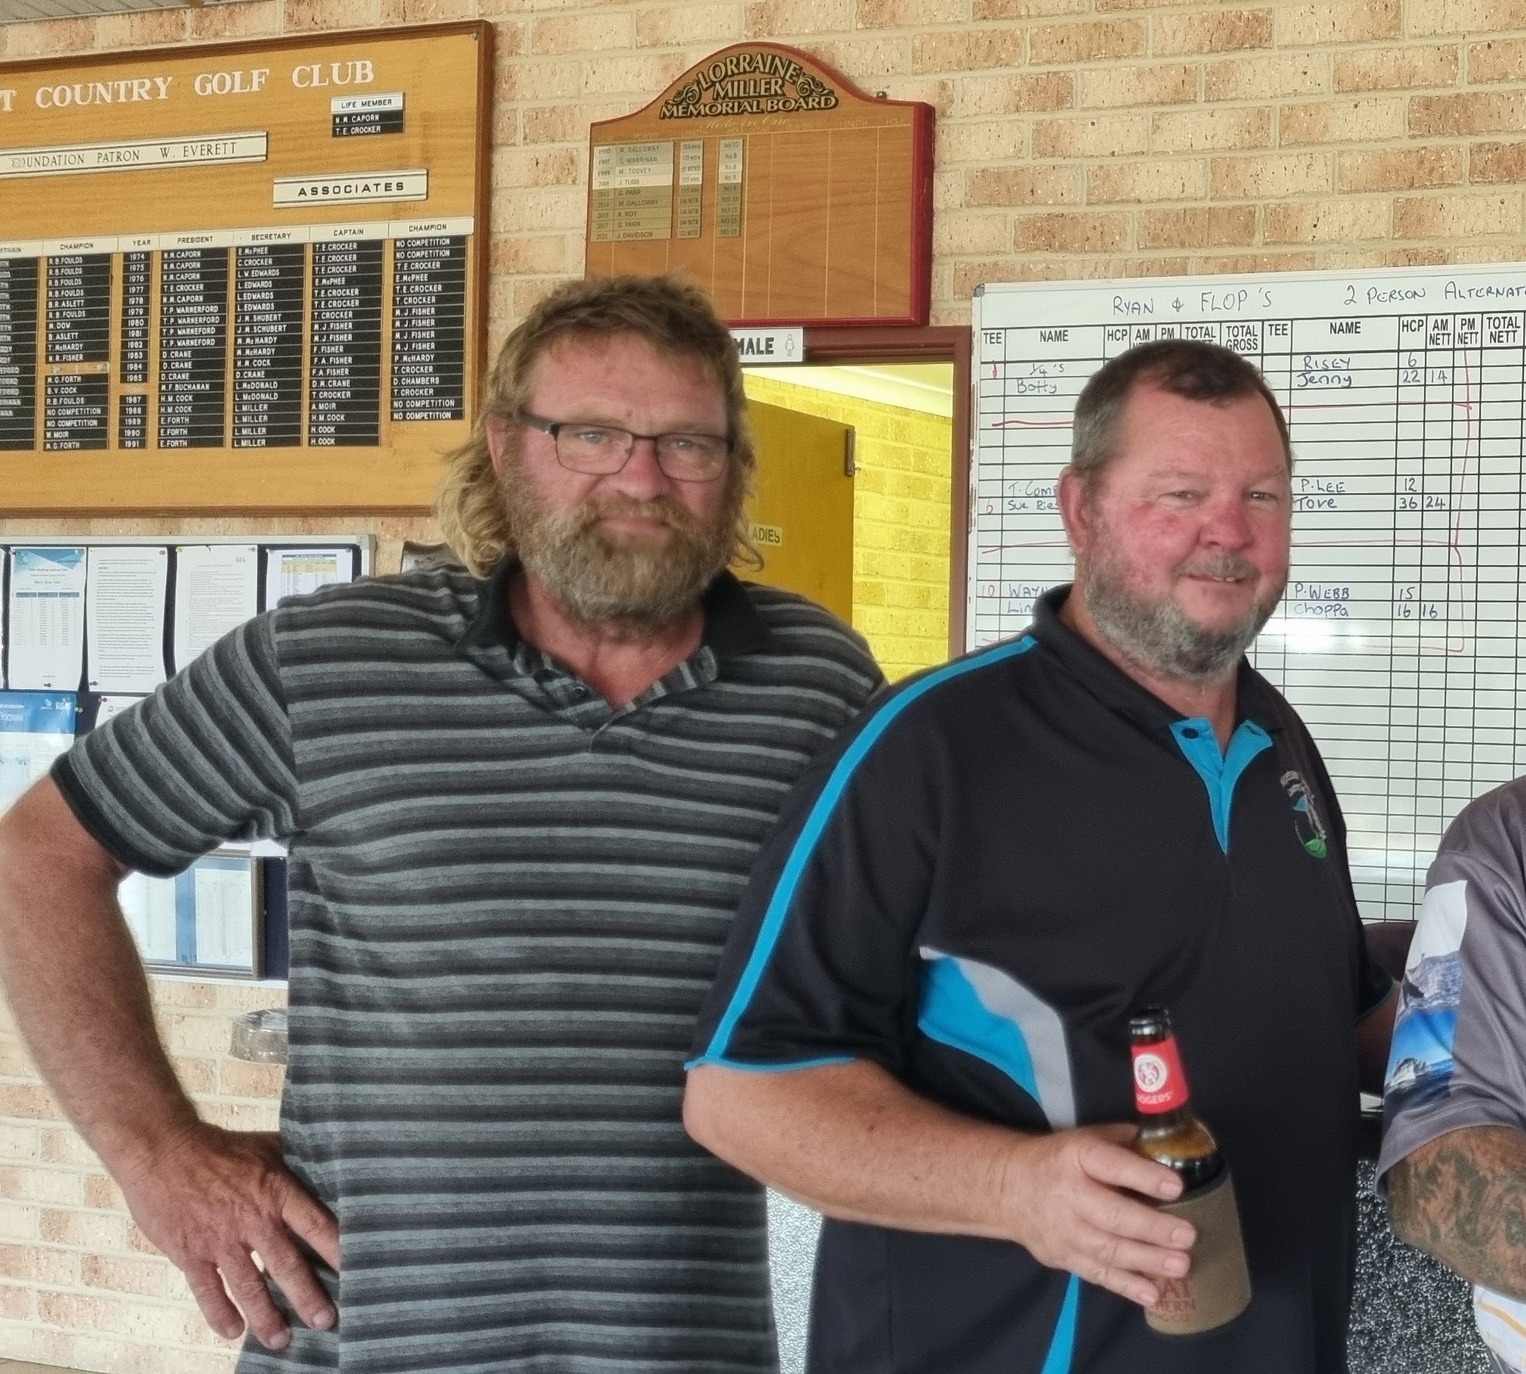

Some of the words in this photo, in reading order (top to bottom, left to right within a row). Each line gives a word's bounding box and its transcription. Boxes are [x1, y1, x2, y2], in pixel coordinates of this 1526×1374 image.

[697, 53, 801, 90] LORRAINE
[35, 77, 173, 108] COUNTRY
[194, 69, 270, 95] GOLF
[292, 60, 374, 88] CLUB
[713, 78, 784, 99] MILLER
[341, 100, 357, 109] LIFE
[361, 99, 392, 107] MEMBER
[660, 100, 762, 119] MEMORIAL
[765, 96, 837, 113] BOARD
[9, 154, 85, 168] UNDATION
[97, 150, 140, 164] PATRON
[183, 142, 237, 157] EVERETT
[298, 182, 404, 196] ASSOCIATES
[408, 224, 447, 232] CHAMPION
[251, 233, 292, 241] SECRETARY
[407, 238, 450, 247] COMPETITION
[1344, 285, 1357, 305] 2
[1367, 287, 1426, 304] PERSON
[1113, 296, 1154, 315] RYAN
[1329, 322, 1361, 335] NAME
[1401, 320, 1424, 333] HCP
[1432, 318, 1448, 331] AM
[1460, 318, 1475, 330] PM
[1486, 316, 1521, 329] TOTAL
[1039, 330, 1069, 342] NAME
[1107, 329, 1127, 341] HCP
[1135, 328, 1150, 340] AM
[1161, 327, 1175, 339] PM
[1185, 326, 1216, 338] TOTAL
[1226, 324, 1258, 337] TOTAL
[1268, 324, 1288, 336] TEE
[1489, 330, 1518, 343] NETT
[983, 332, 1002, 344] TEE
[1225, 338, 1258, 350] GROSS
[1429, 333, 1451, 346] NETT
[1457, 332, 1479, 345] NETT
[1407, 351, 1417, 367] 6
[1297, 372, 1352, 387] Jenny
[1402, 370, 1421, 383] 22
[1430, 370, 1447, 383] 14
[57, 407, 101, 415] COMPETITION
[1405, 477, 1417, 491] 12
[1399, 497, 1418, 509] 36
[1425, 496, 1446, 510] 24
[751, 526, 781, 544] ADIES
[1400, 587, 1415, 600] 15
[1398, 604, 1411, 617] 16
[1423, 603, 1438, 618] 16
